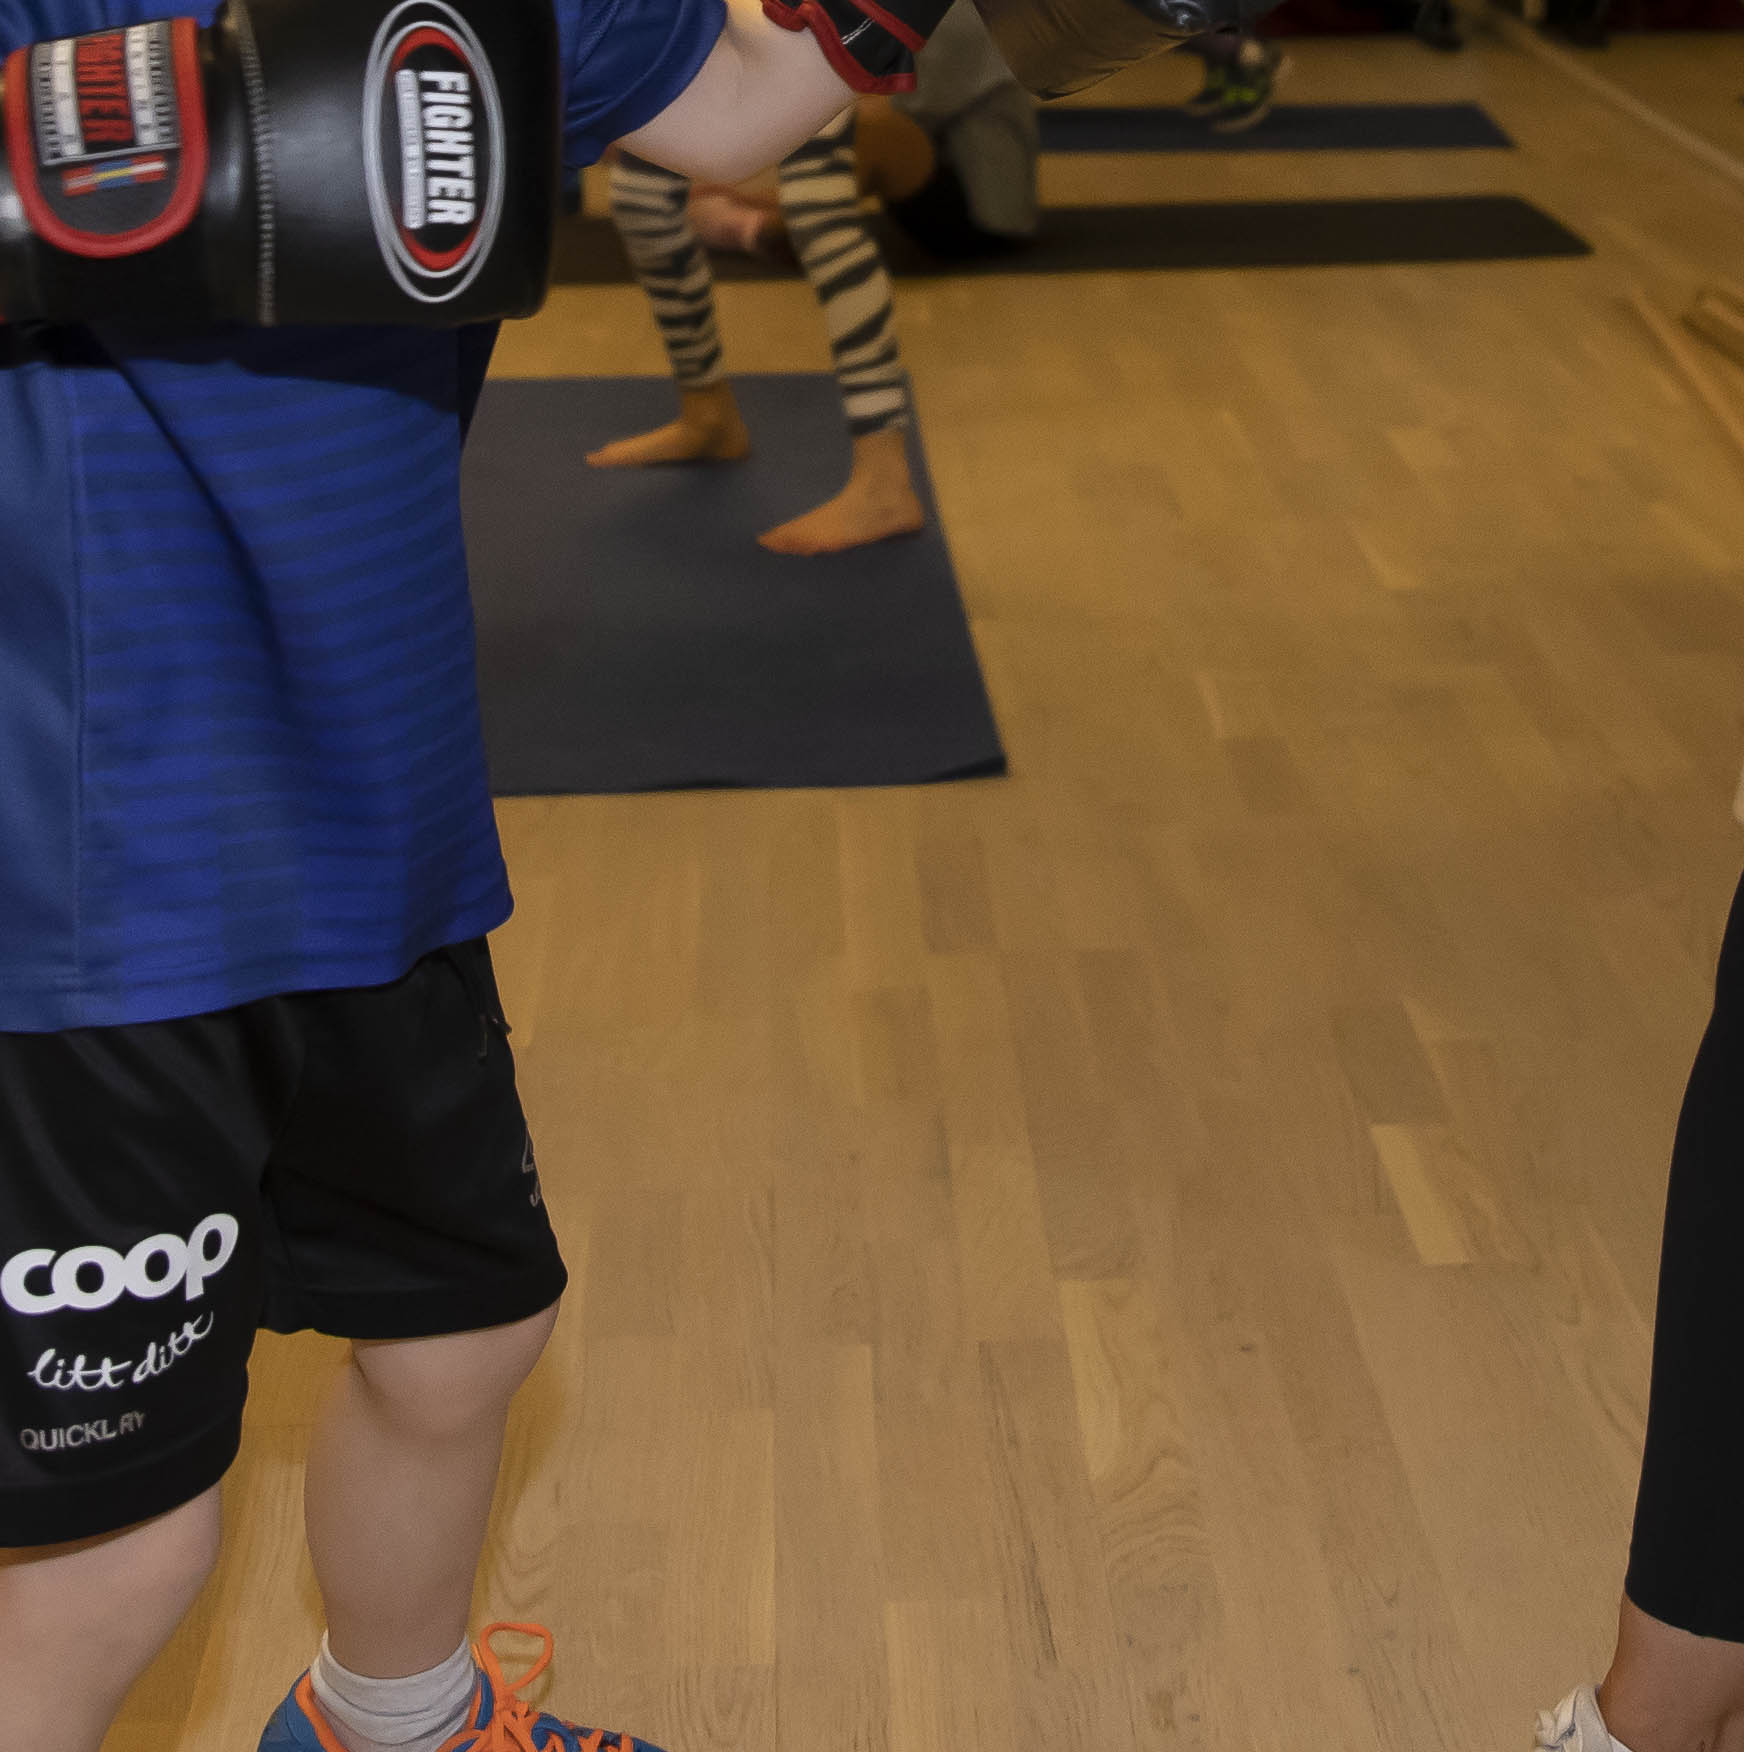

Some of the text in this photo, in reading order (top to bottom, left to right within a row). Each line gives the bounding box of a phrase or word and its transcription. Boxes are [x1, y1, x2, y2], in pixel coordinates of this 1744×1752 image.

[419, 70, 477, 225] FIGHTER
[0, 1212, 239, 1315] coop
[26, 1348, 133, 1391] litt
